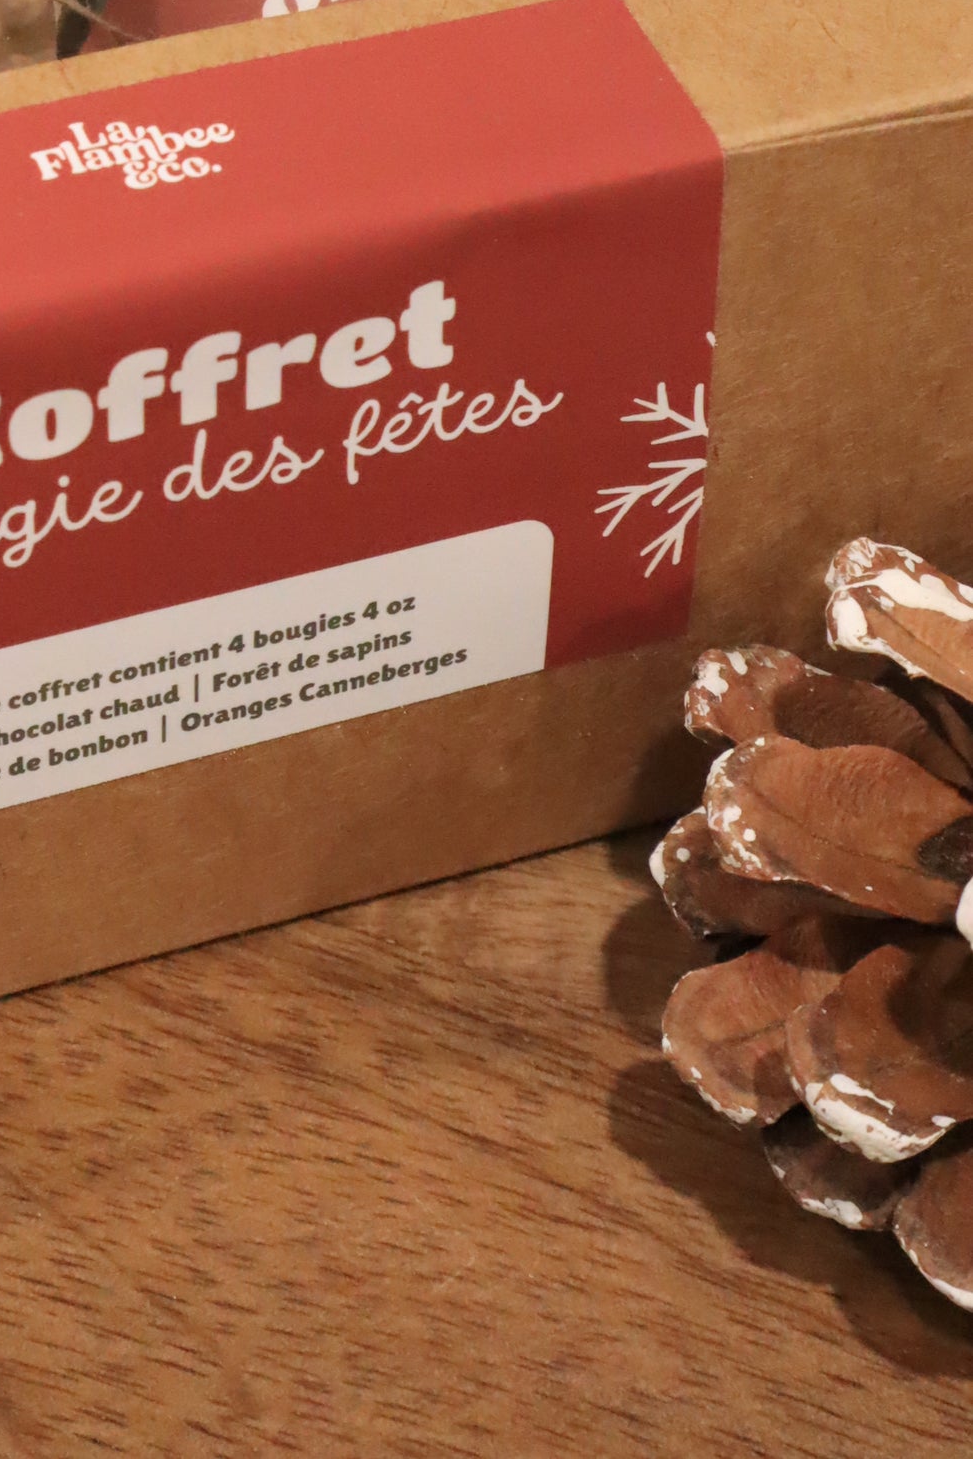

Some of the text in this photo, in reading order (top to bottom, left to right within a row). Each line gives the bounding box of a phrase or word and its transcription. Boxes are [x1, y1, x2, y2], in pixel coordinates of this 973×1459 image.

[30, 122, 236, 181] Flambee
[68, 120, 133, 151] La
[163, 429, 324, 501] des
[342, 379, 564, 484] fêtes
[8, 671, 103, 710] coffret
[109, 639, 222, 685] contient
[227, 634, 246, 654] 4
[253, 609, 357, 651] bougies
[361, 600, 380, 621] 4
[386, 596, 417, 617] oz
[100, 683, 180, 722] chaud
[212, 659, 282, 694] Forêt
[288, 649, 321, 674] de
[327, 628, 412, 664] sapins
[8, 753, 41, 777] de
[48, 726, 149, 768] bonbon
[180, 691, 293, 734] Oranges
[299, 650, 469, 703] Canneberges
